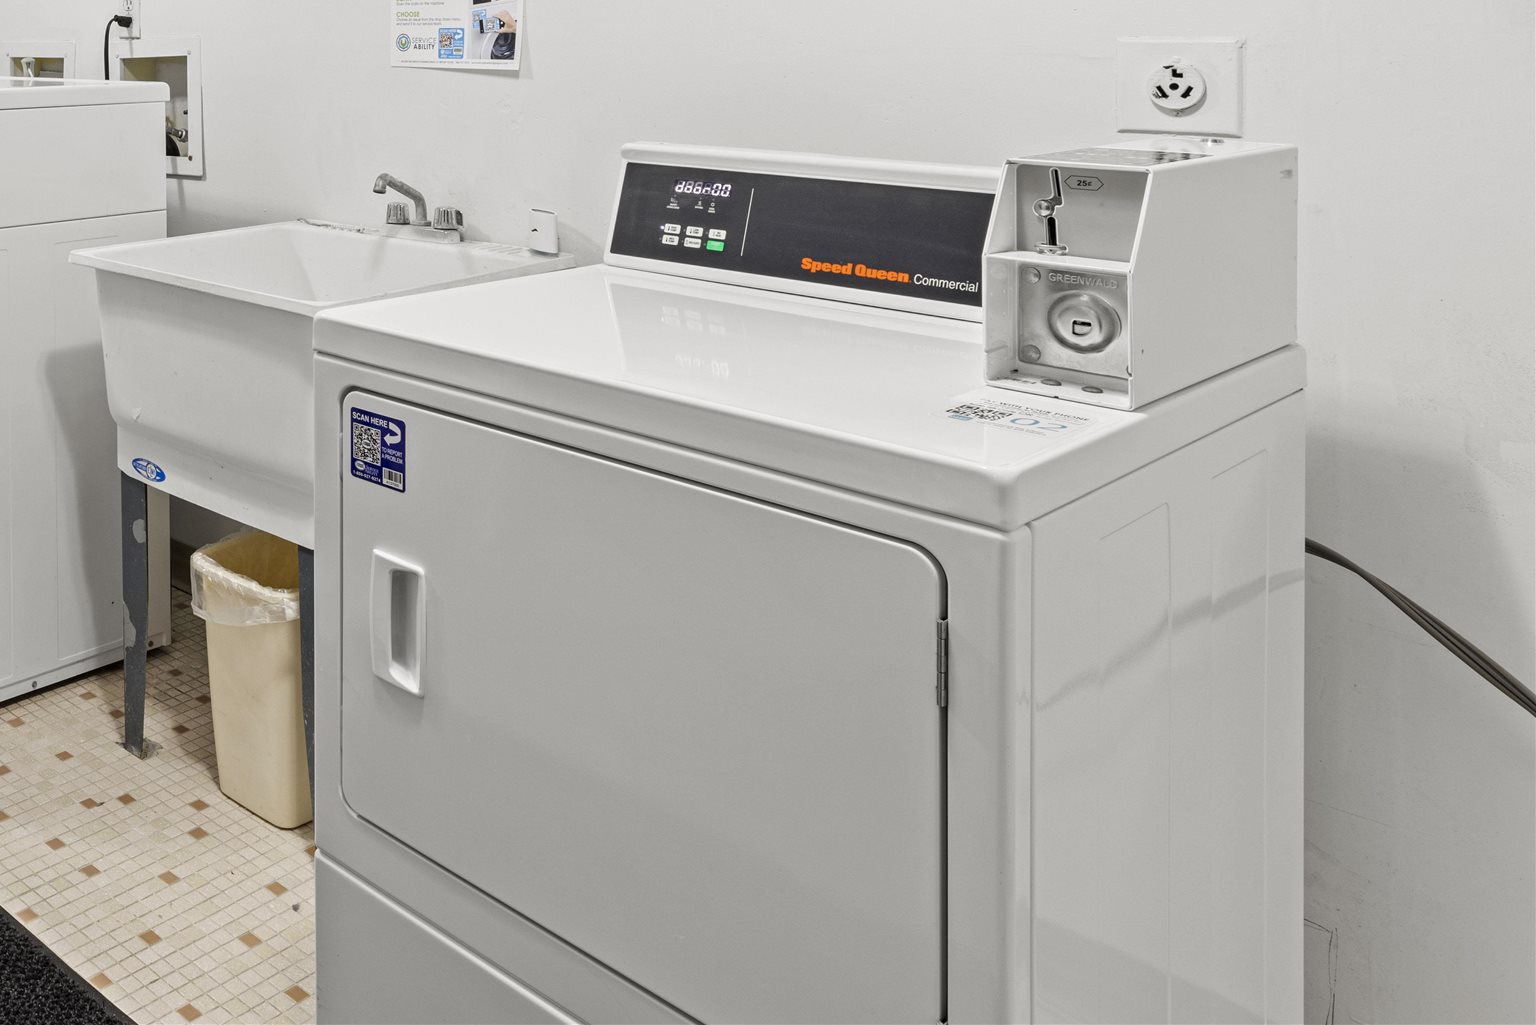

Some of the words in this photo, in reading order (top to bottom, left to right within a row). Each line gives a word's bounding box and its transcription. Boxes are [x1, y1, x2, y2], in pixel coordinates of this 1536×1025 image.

[801, 257, 852, 277] Speed
[855, 263, 910, 284] Queen
[914, 273, 979, 293] Commercial
[1048, 272, 1118, 290] GREENWALD
[352, 412, 369, 423] SCAN
[370, 416, 388, 428] HERE
[1025, 407, 1052, 415] YOUR
[1055, 412, 1089, 422] PHONE
